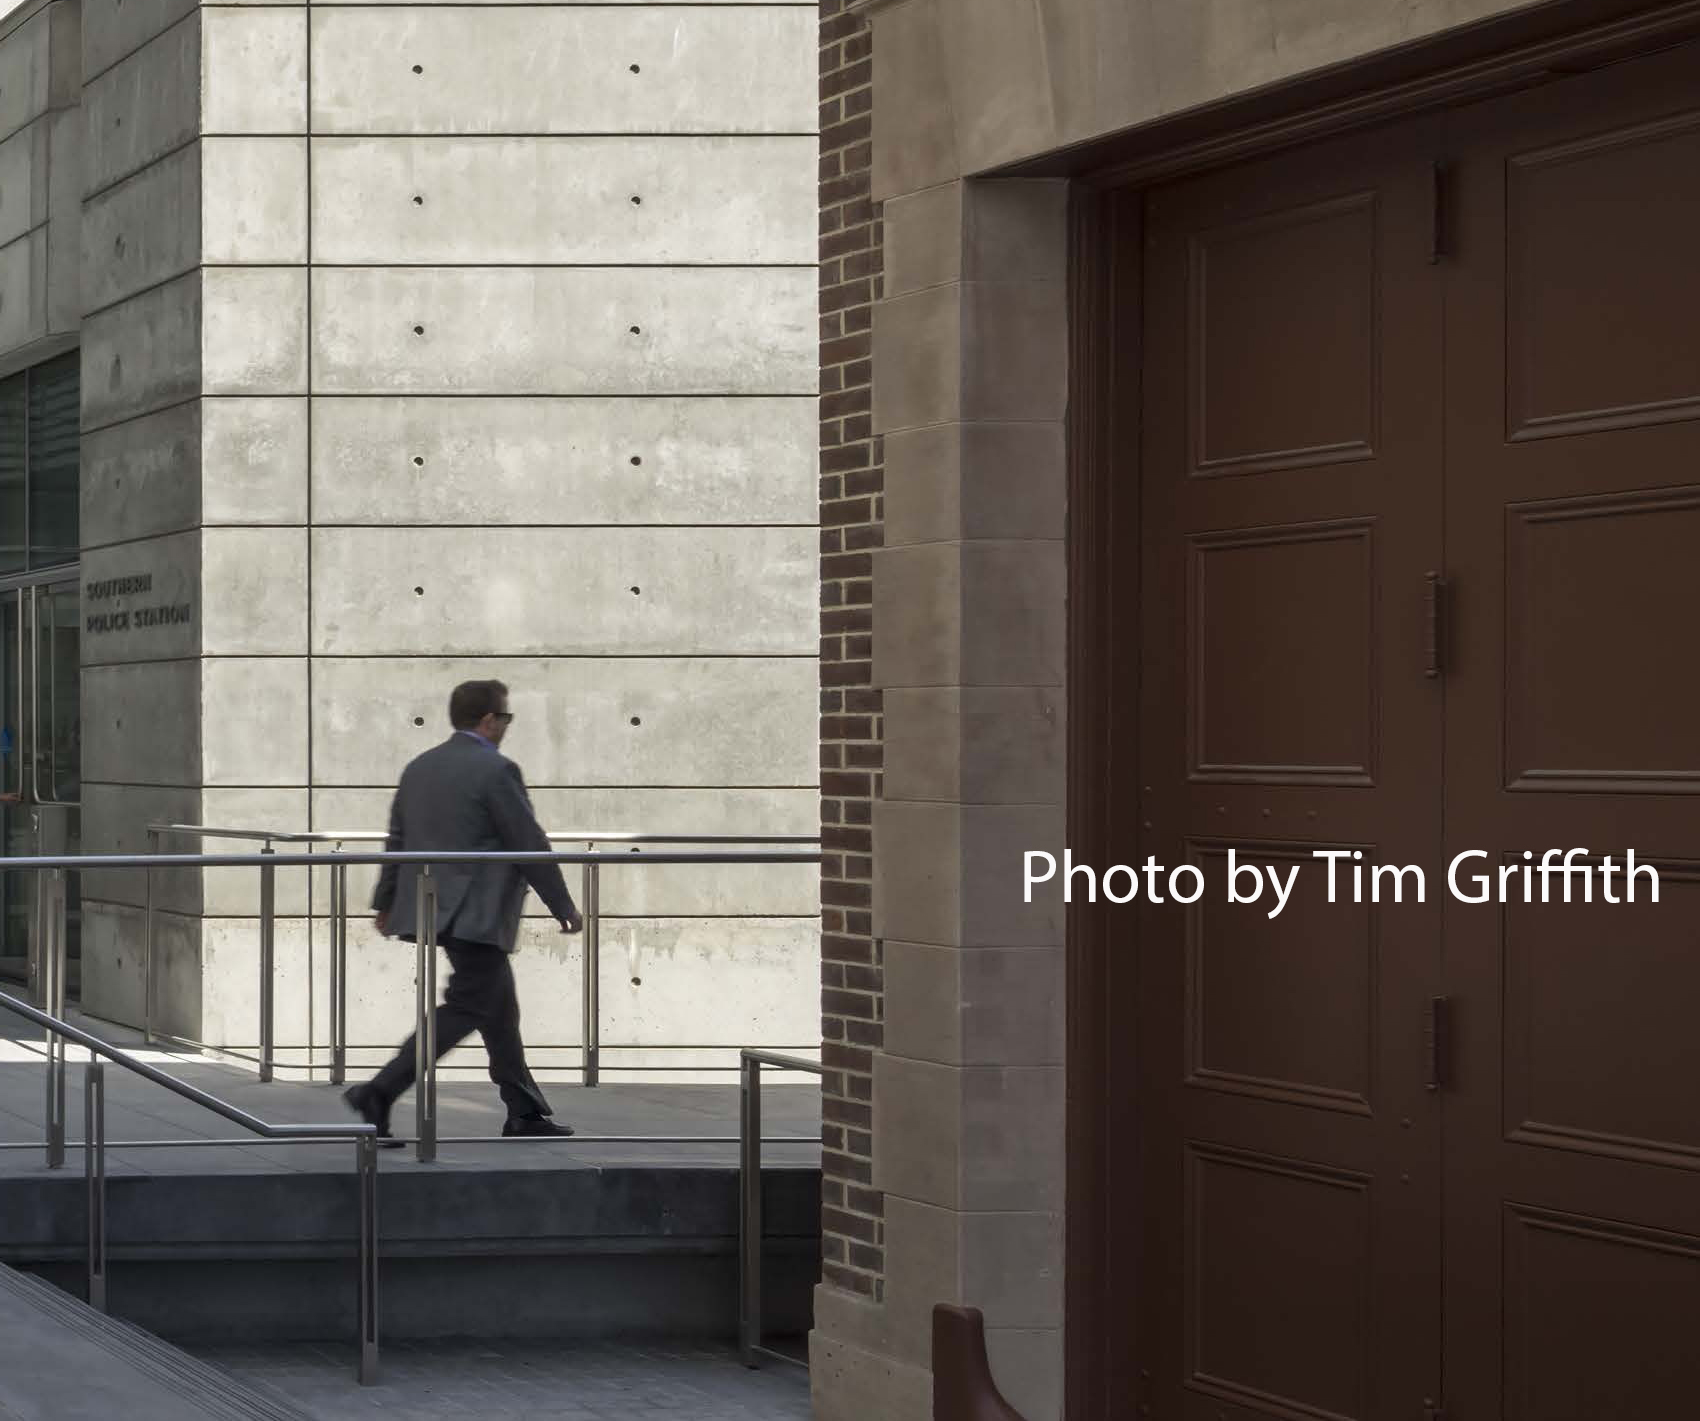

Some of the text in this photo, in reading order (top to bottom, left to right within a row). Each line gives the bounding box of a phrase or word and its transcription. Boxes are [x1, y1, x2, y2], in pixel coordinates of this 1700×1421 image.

[86, 573, 153, 602] SOUTHERN
[86, 603, 192, 633] POLICE STATION
